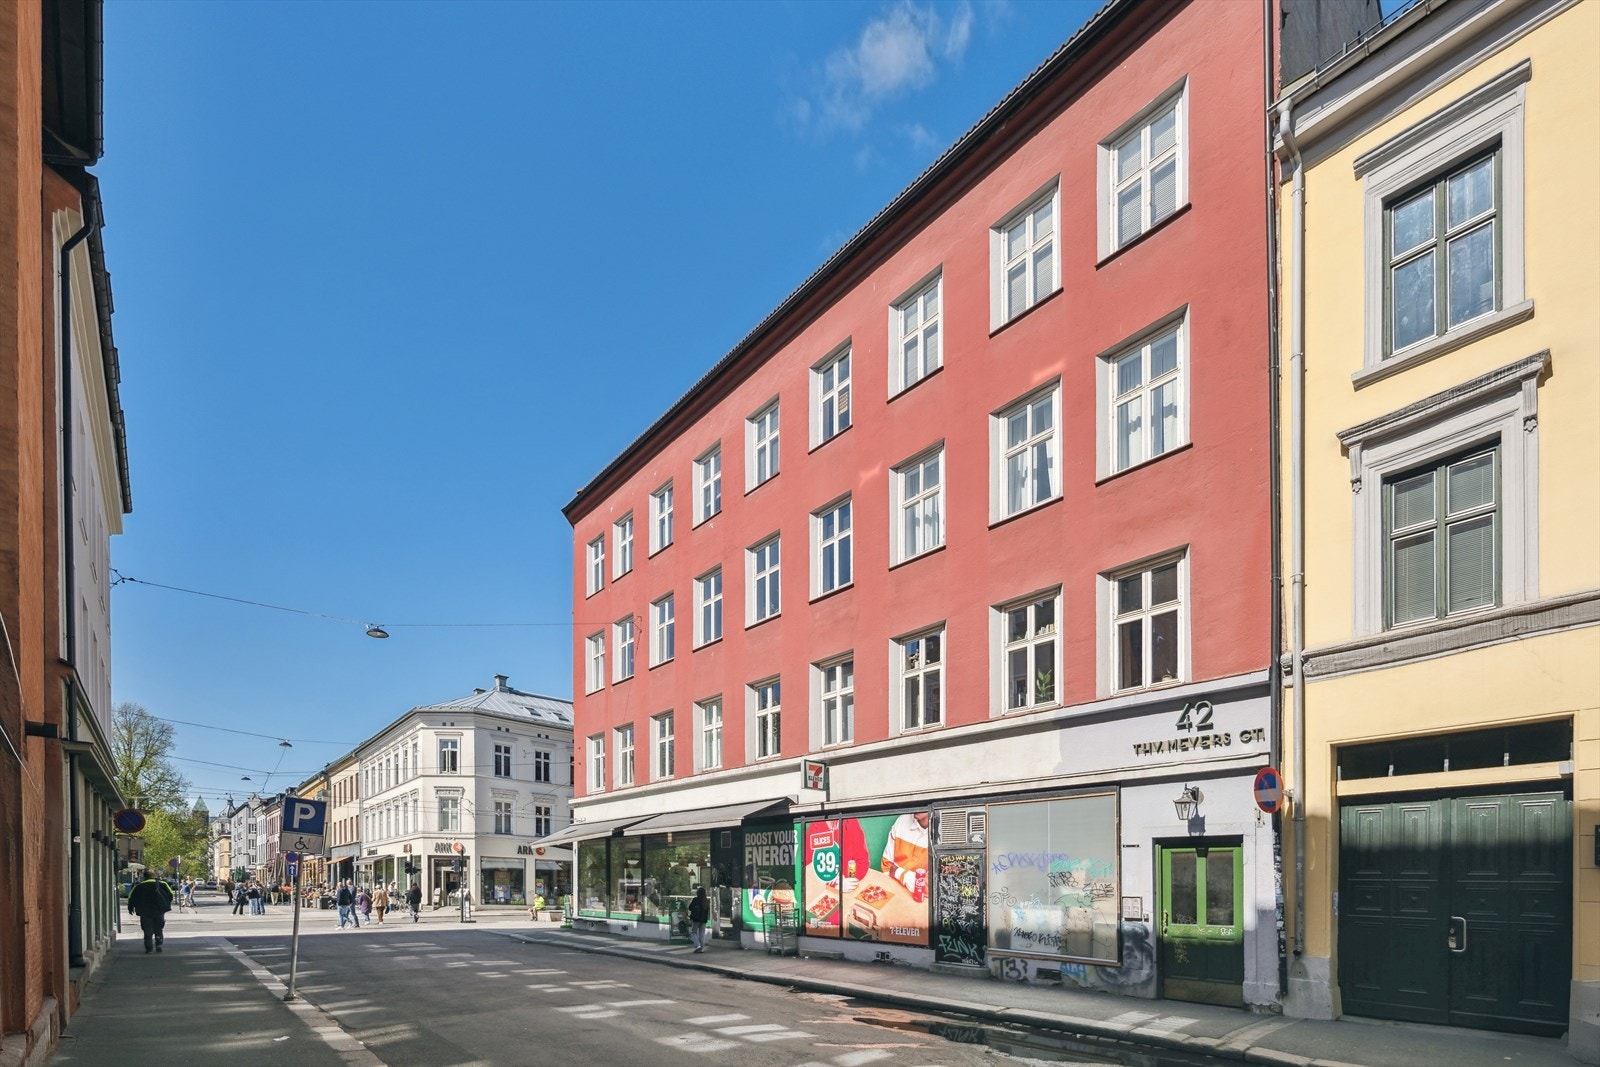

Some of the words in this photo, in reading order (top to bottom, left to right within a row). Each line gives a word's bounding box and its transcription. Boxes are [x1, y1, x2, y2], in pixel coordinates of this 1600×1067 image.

[1175, 700, 1214, 732] 42
[293, 802, 316, 829] P
[745, 831, 772, 845] BOOST
[773, 829, 799, 844] YOUR
[813, 835, 831, 846] SLICES
[745, 844, 799, 866] ENERGY
